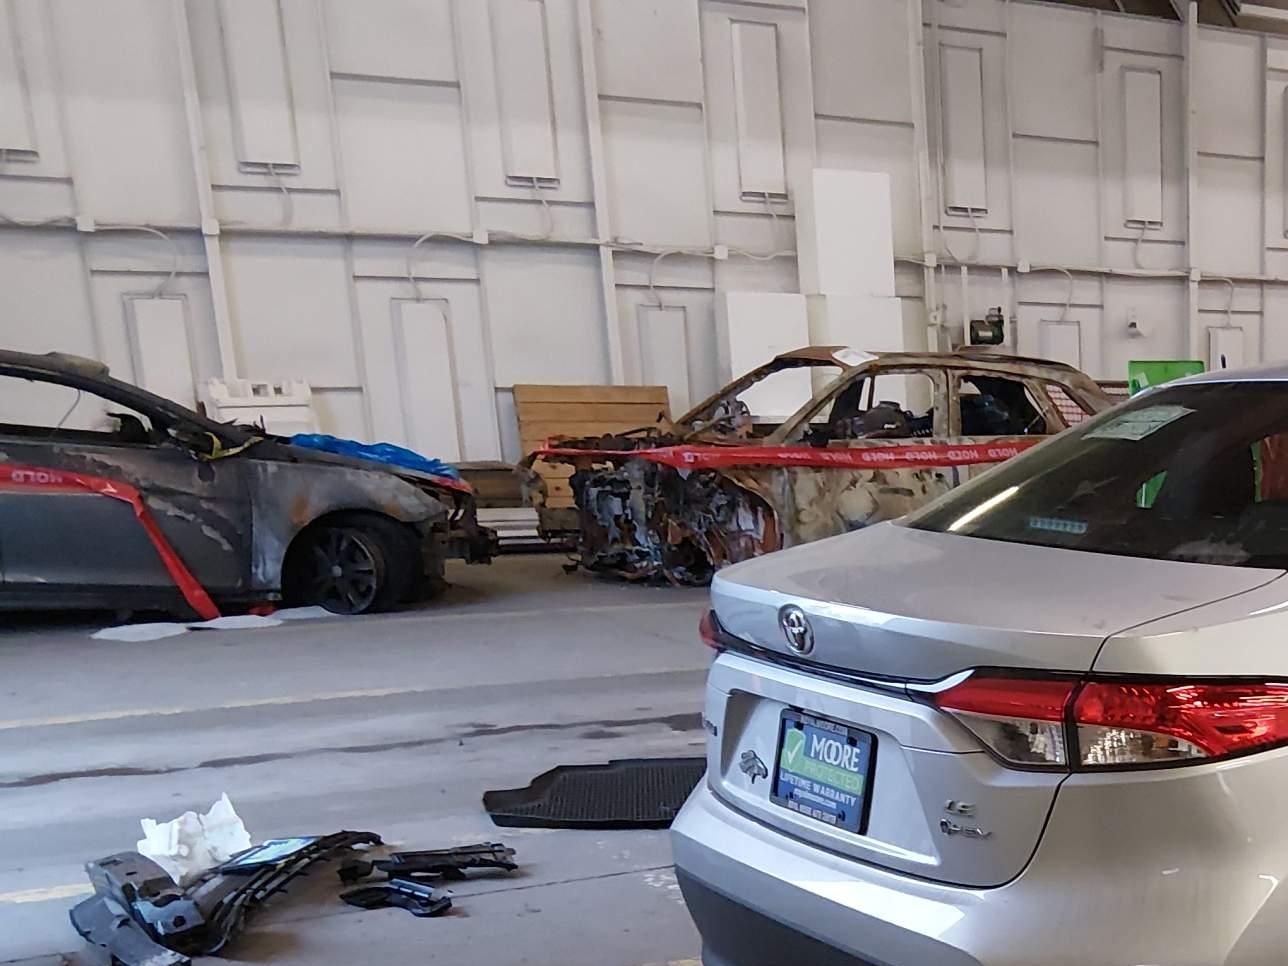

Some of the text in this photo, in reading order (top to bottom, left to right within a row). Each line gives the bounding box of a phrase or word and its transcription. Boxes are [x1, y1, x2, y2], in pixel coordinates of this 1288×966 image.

[905, 450, 938, 462] HOLD
[948, 449, 979, 461] HOLD
[11, 469, 63, 483] HOLD
[810, 733, 861, 772] MOORE
[813, 782, 857, 807] WARRANTY
